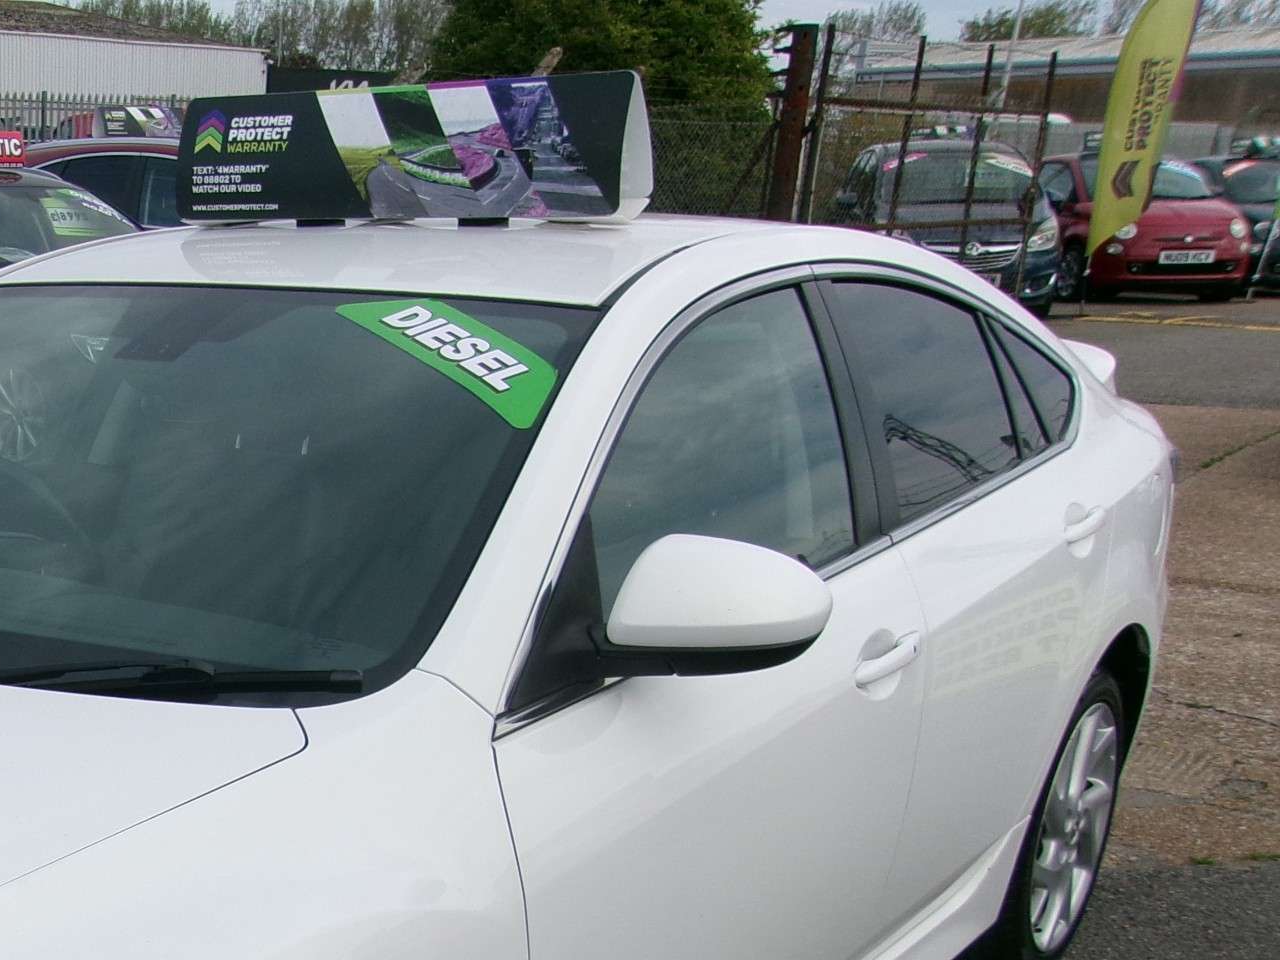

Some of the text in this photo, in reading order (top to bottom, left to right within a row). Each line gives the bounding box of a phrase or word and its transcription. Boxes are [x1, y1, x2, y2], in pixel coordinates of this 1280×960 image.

[230, 115, 293, 128] CUSTOMER
[228, 127, 292, 142] PROTECT
[227, 141, 289, 153] WARRANTY
[192, 166, 215, 174] TEXT:
[192, 176, 203, 184] TO
[231, 175, 241, 183] TO
[192, 184, 262, 194] WATCH OUR VIDEO
[380, 305, 529, 393] DIESEL
